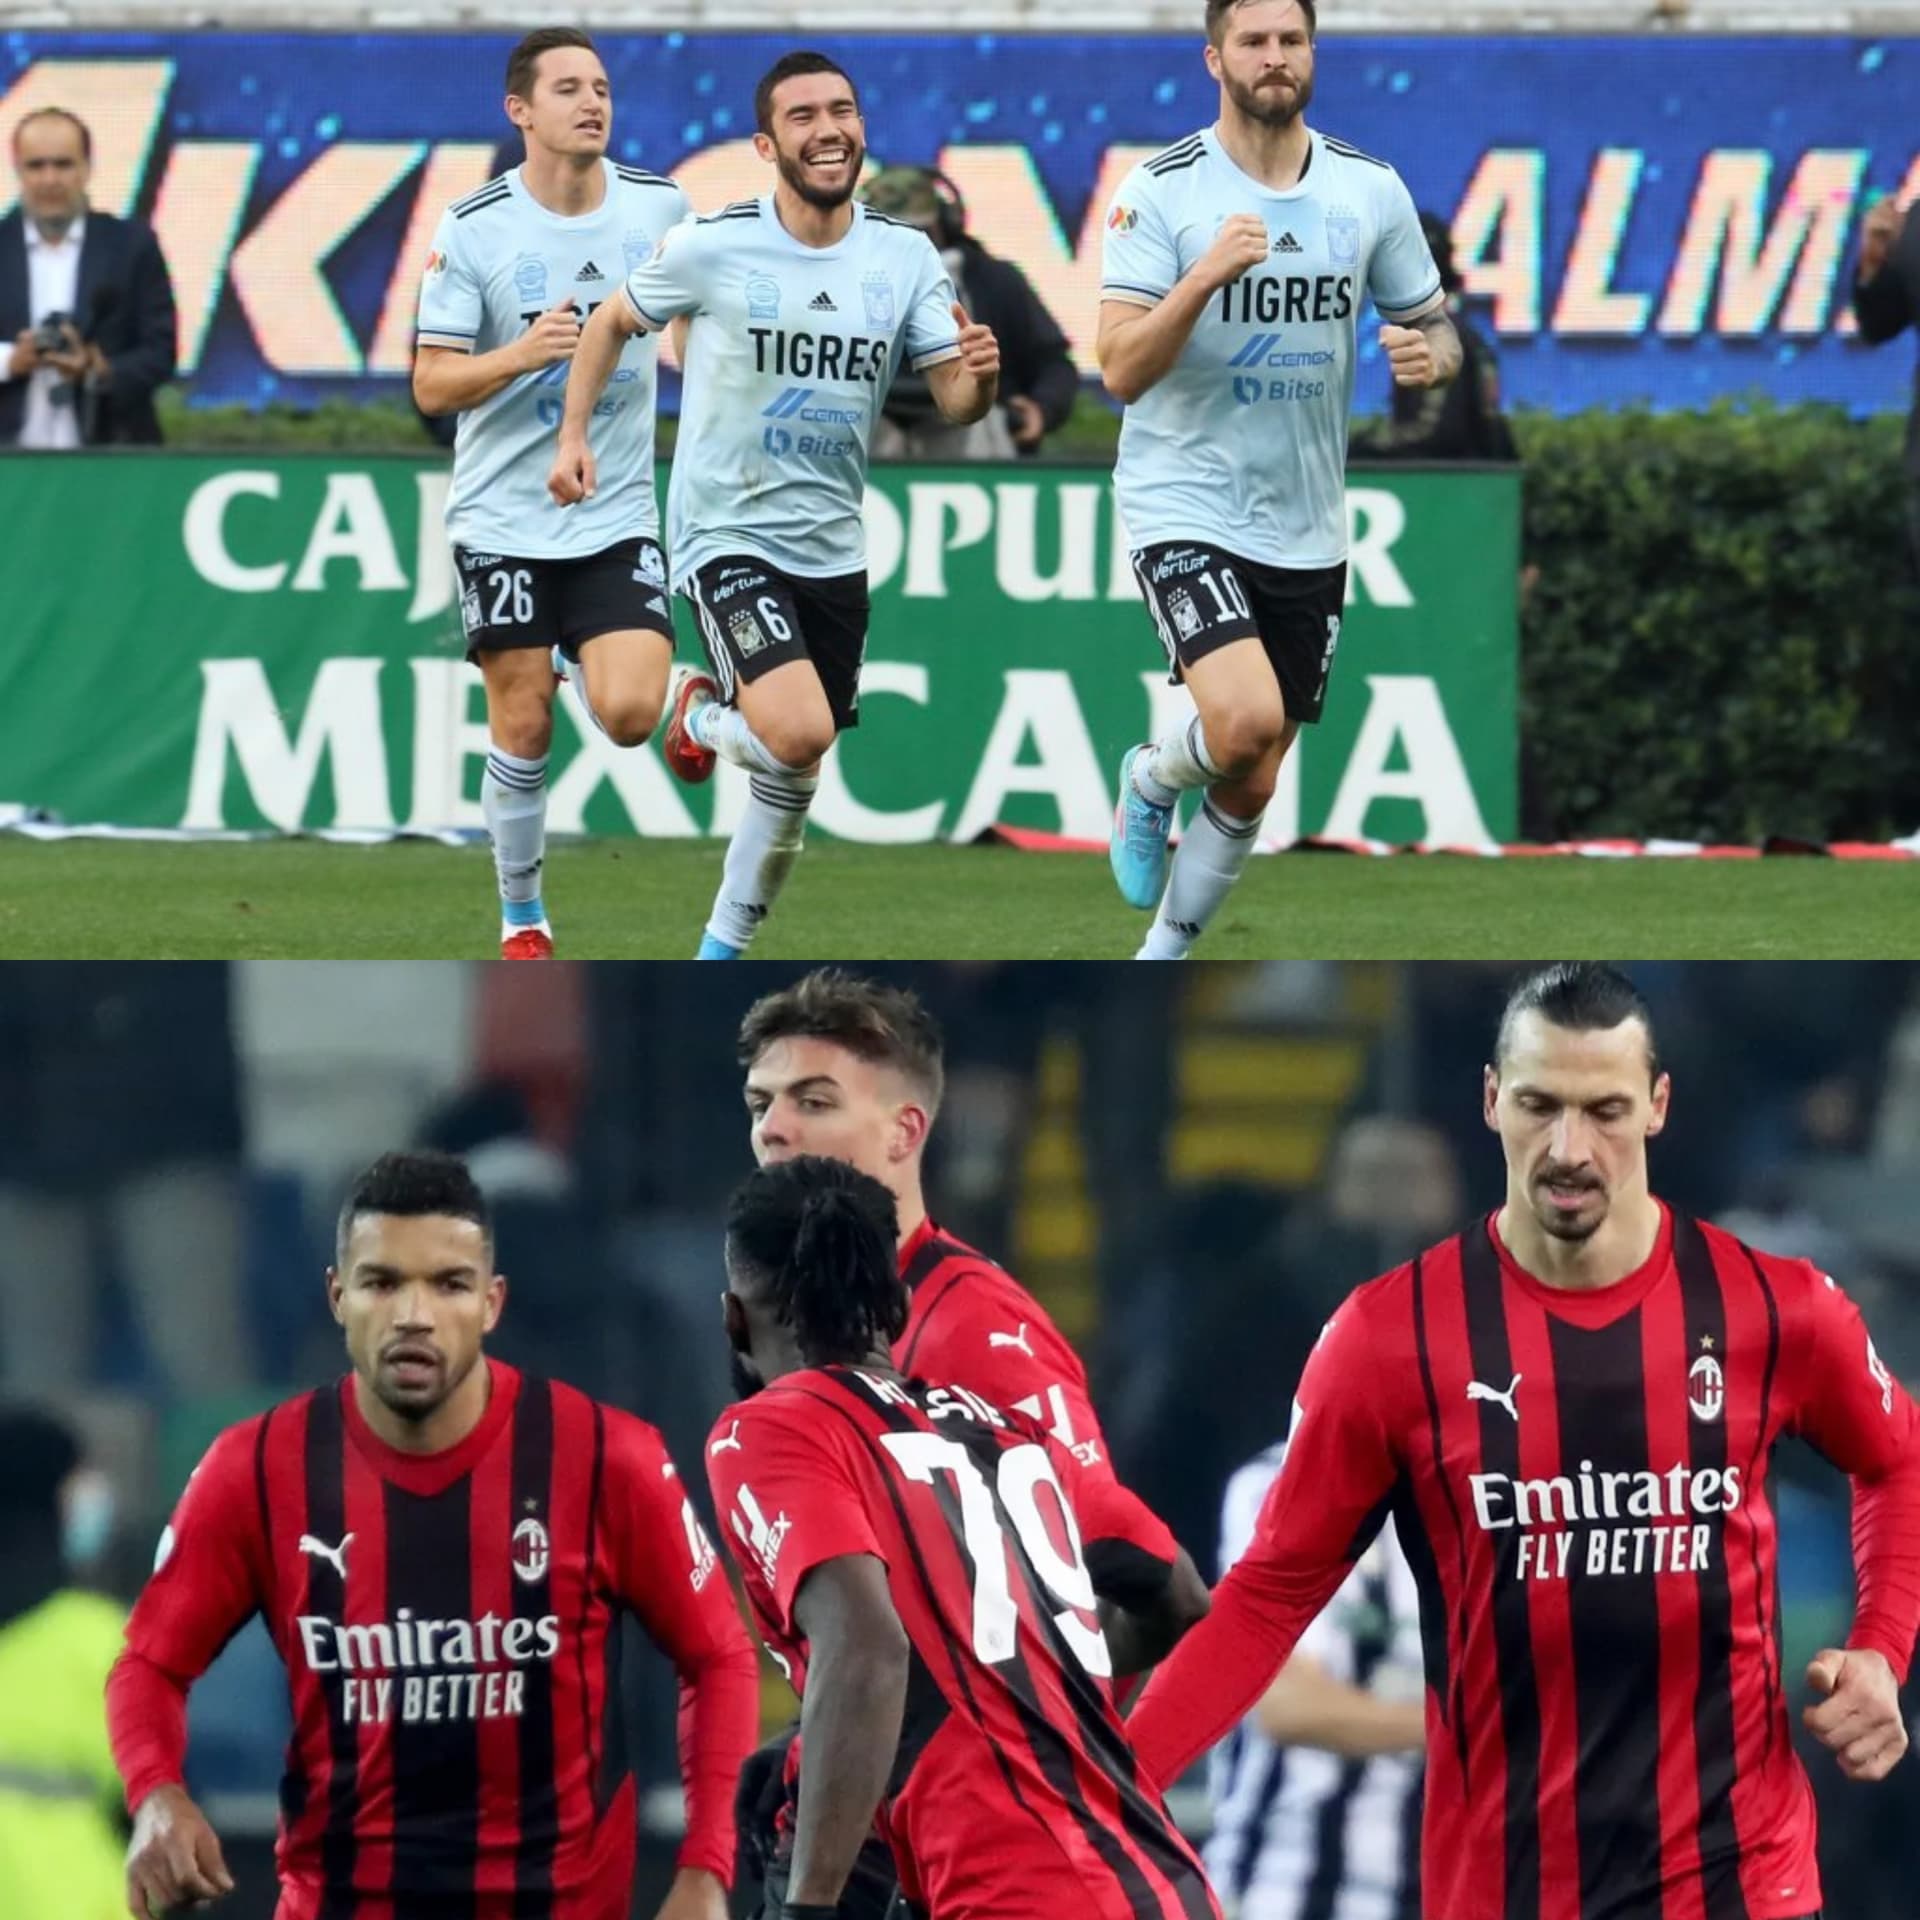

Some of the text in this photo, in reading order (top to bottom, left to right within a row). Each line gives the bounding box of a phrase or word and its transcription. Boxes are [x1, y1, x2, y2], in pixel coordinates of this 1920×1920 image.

[1453, 148, 1920, 334] ALM
[1220, 275, 1352, 323] TIGRES
[747, 327, 888, 382] TIGRES
[1268, 377, 1325, 400] Bitso
[182, 470, 457, 623] CAJ
[488, 569, 534, 625] 26
[757, 596, 793, 642] 6
[1198, 568, 1251, 623] 10
[1468, 1459, 1742, 1531] Emirates
[879, 1431, 1112, 1678] 79
[1516, 1524, 1710, 1580] FLY BETTER
[297, 1607, 559, 1672] Emirates
[342, 1671, 524, 1724] FLY BETTER
